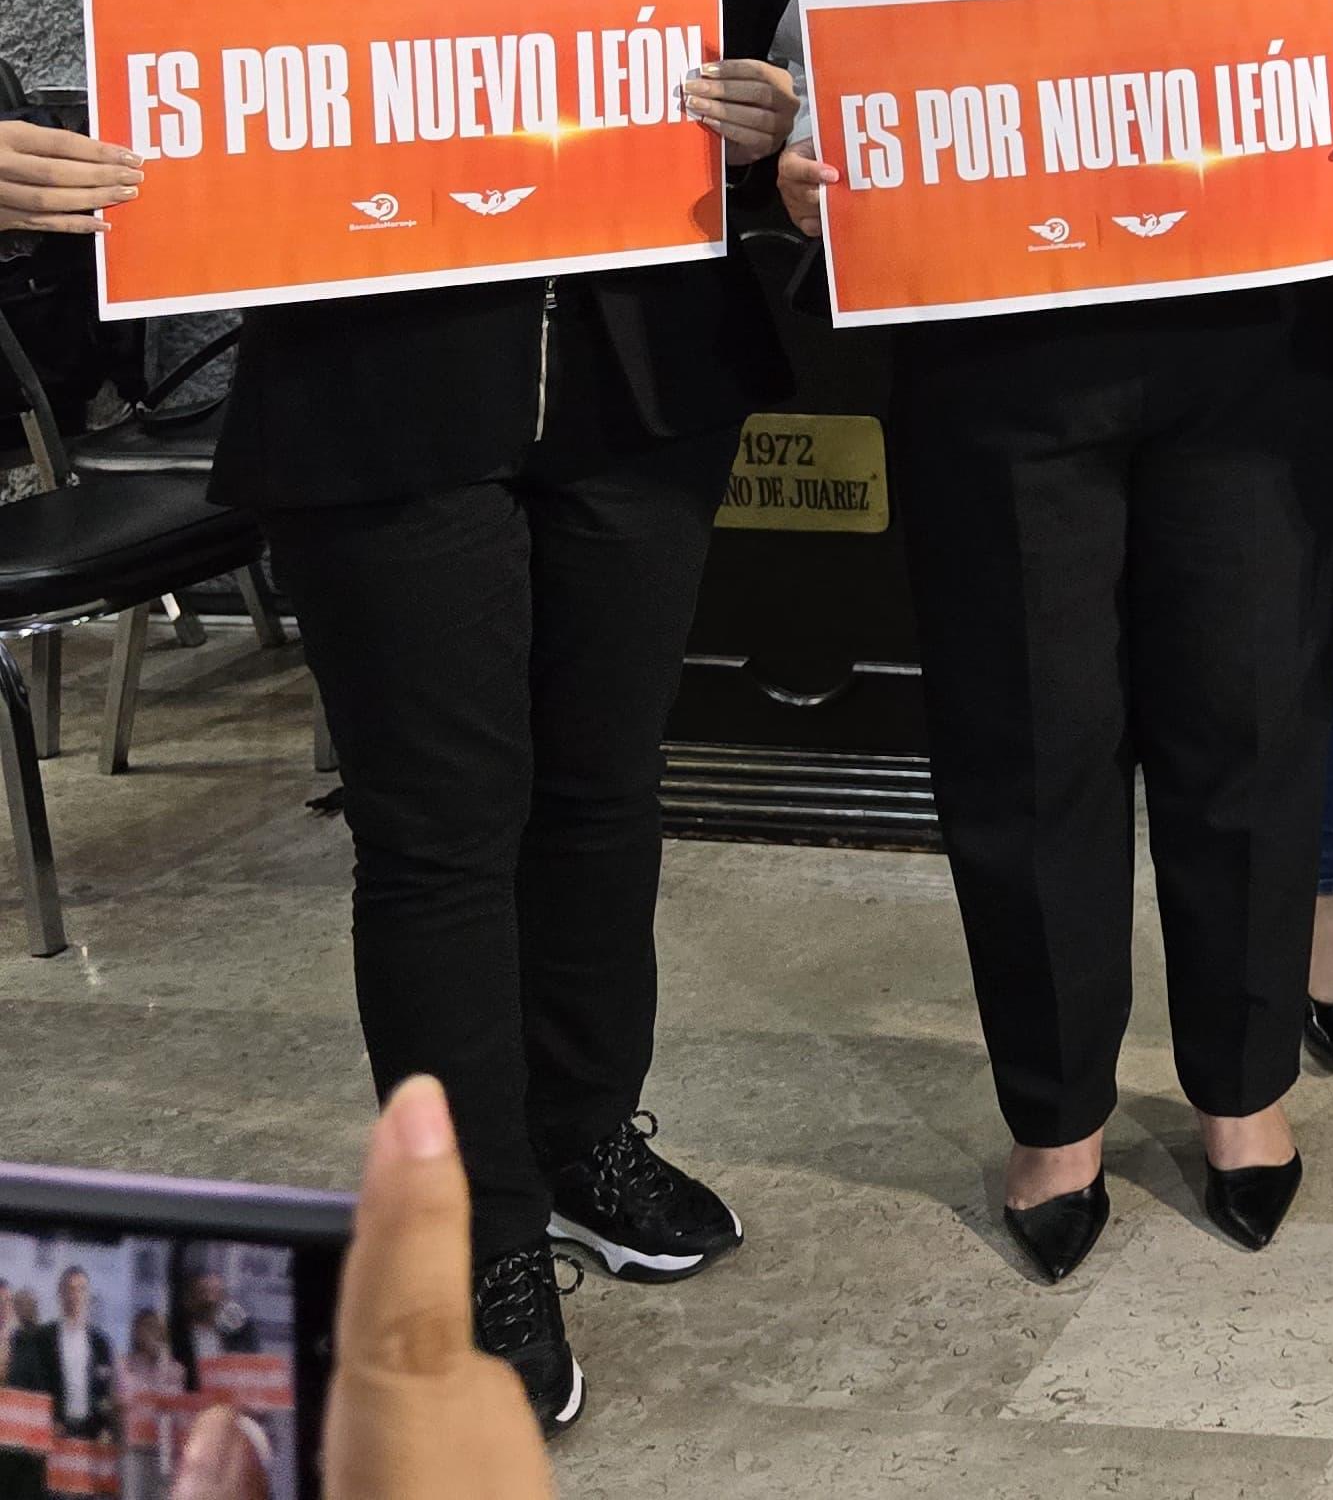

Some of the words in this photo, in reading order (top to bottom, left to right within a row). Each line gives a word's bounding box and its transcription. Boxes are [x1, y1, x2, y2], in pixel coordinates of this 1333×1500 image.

[127, 51, 201, 161] ES
[221, 44, 351, 154] POR
[370, 32, 559, 144] NUEVO
[577, 6, 701, 129] LEÓN
[840, 92, 904, 190] ES
[916, 83, 1026, 184] POR
[1037, 68, 1203, 173] NUEVO
[1215, 39, 1332, 156] LEÓN
[743, 431, 815, 467] 1972
[757, 476, 784, 508] DE
